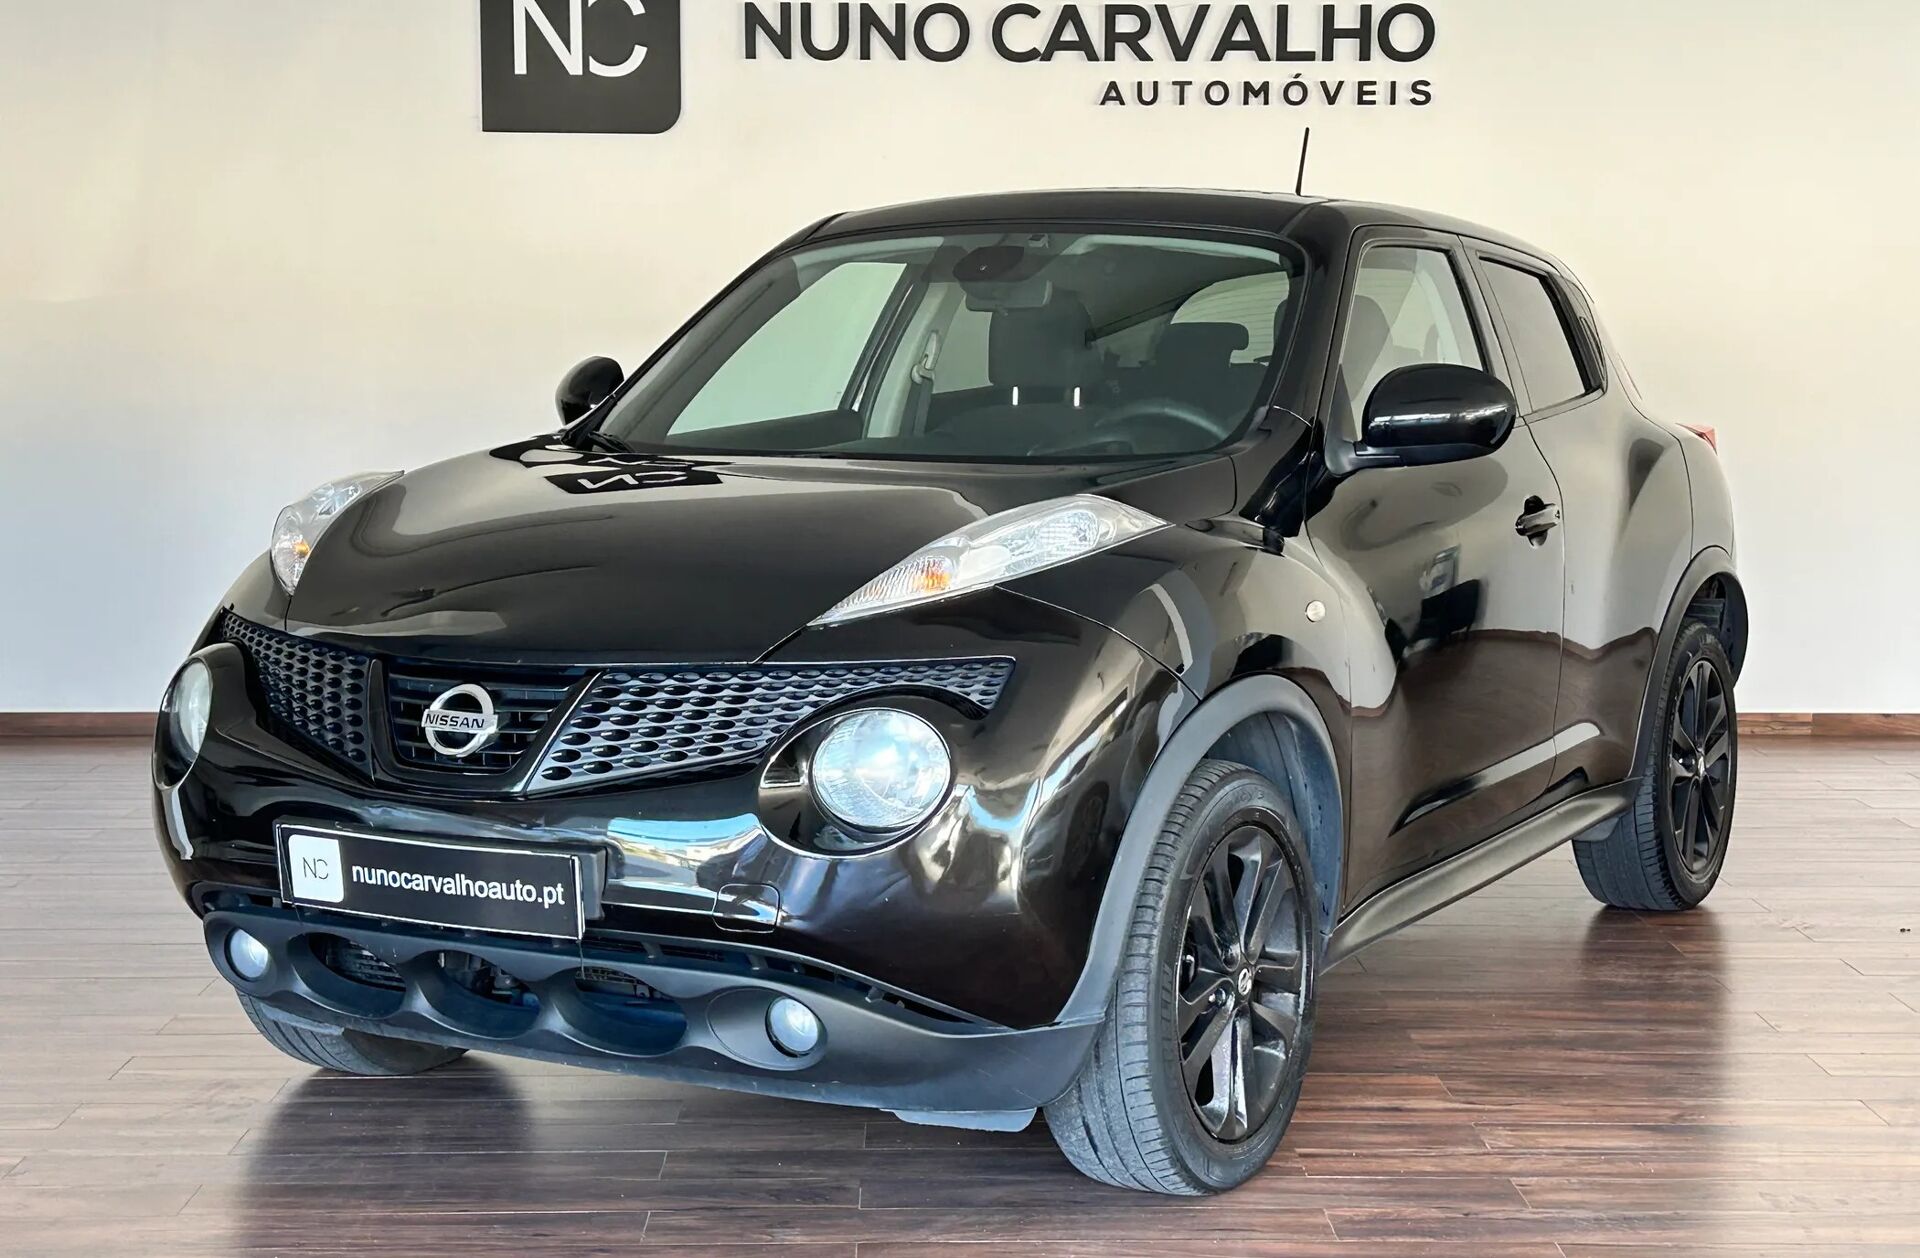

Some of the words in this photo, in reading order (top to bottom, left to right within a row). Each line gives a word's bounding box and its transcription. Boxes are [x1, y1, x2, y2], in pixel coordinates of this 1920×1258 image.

[513, 0, 648, 78] NC
[744, 2, 971, 62] NUNO
[991, 2, 1436, 63] CARVALHO
[1099, 73, 1432, 106] AUTOMÓVEIS
[424, 713, 485, 729] NISSAN
[302, 856, 329, 880] NC
[351, 864, 566, 909] nunocarvalhoauto.pt
